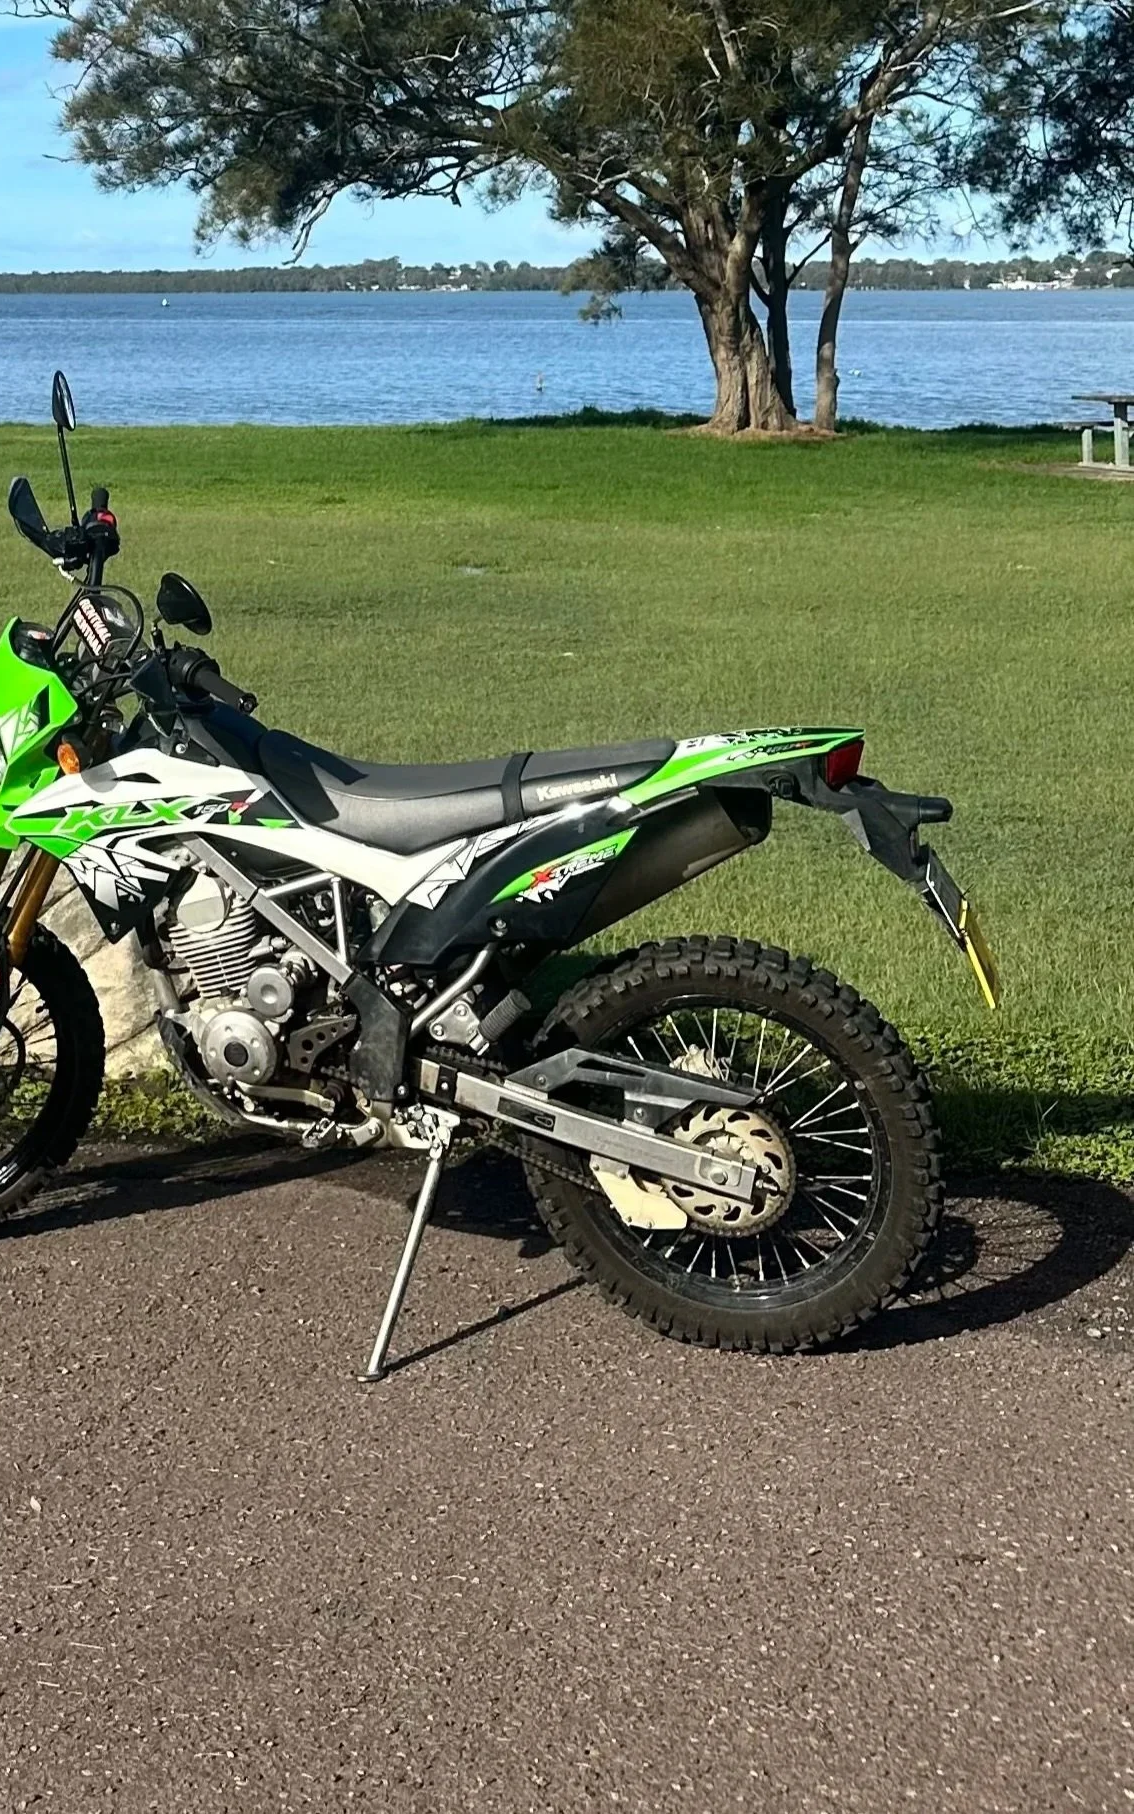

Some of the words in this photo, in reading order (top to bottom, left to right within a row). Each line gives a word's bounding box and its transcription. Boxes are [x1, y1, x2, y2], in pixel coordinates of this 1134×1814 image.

[536, 773, 619, 802] Kawasaki
[52, 797, 199, 834] KLX
[193, 802, 232, 816] 150
